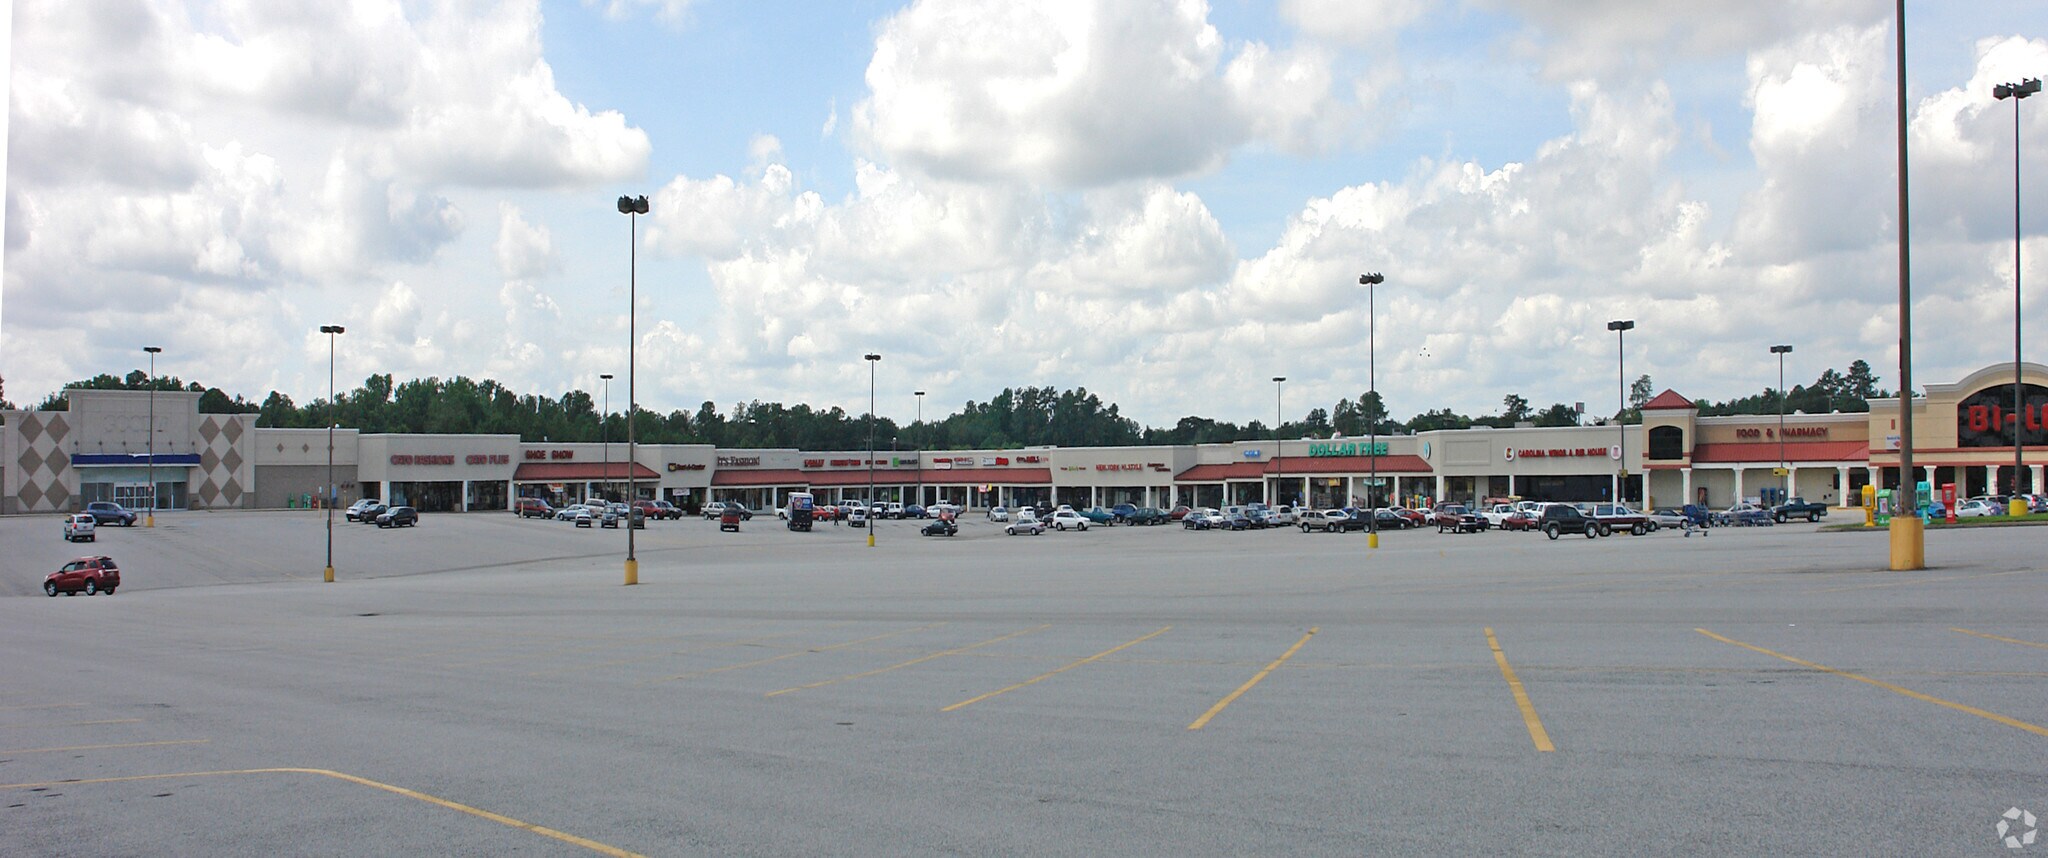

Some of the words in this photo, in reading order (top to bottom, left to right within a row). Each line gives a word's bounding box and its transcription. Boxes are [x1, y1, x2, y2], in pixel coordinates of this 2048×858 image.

[1736, 428, 1760, 438] FOOD
[1766, 428, 1773, 437] &
[525, 450, 546, 459] SHOE
[552, 450, 574, 459] SHOW
[1309, 443, 1356, 457] DOLLAR
[1358, 442, 1388, 456] TREE
[1518, 449, 1545, 458] CAROLINA
[1587, 447, 1607, 456] HOUSE
[390, 455, 413, 465] CATO
[466, 455, 487, 465] CATO
[489, 455, 509, 465] PLUS
